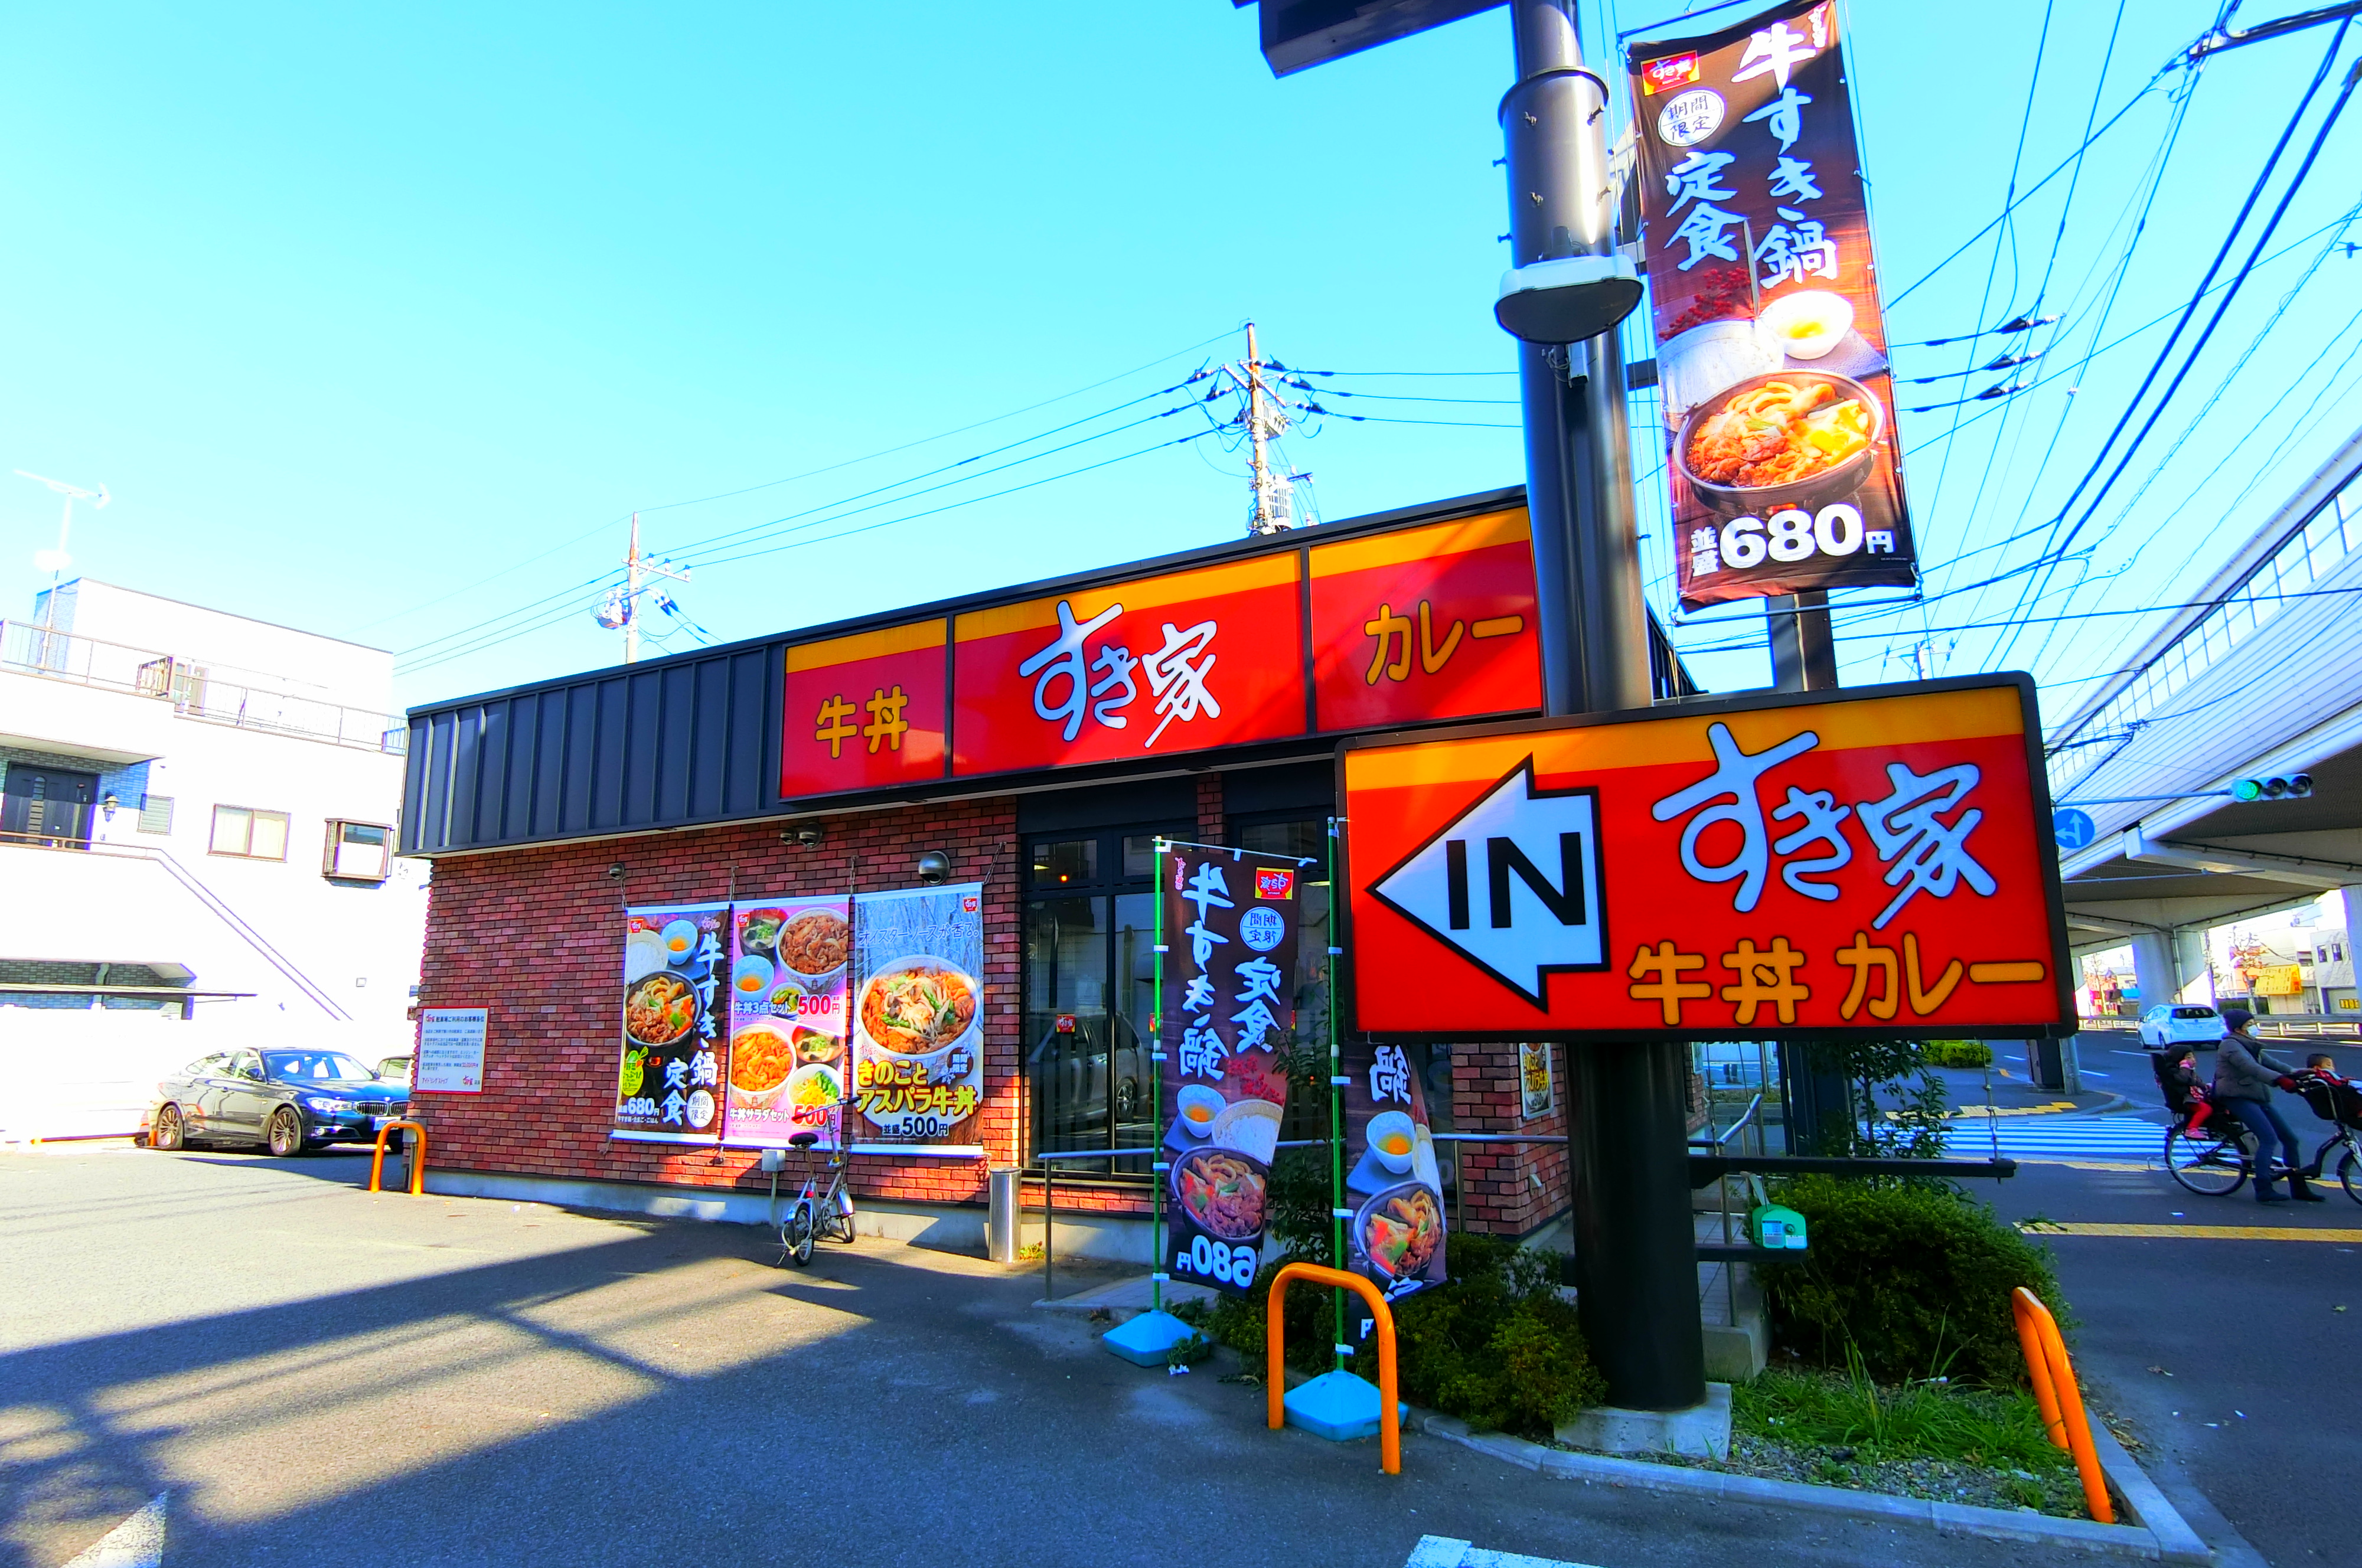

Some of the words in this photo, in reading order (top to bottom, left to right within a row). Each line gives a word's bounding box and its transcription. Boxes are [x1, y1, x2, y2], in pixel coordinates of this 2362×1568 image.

[1650, 57, 1692, 80] すき家
[1668, 95, 1708, 120] 期間
[1670, 116, 1712, 141] 限定
[1731, 22, 1838, 289] 牛すき鍋
[1665, 151, 1747, 272] 定食
[1720, 504, 1894, 569] 680円
[1365, 599, 1523, 686] カレー
[1019, 600, 1221, 749] すき家
[815, 684, 909, 759] 牛丼
[1652, 721, 1998, 930] すき家
[1446, 832, 1586, 930] IN
[859, 922, 980, 945] オイスターソースが香る。
[1628, 937, 1810, 1027] 牛丼
[1835, 930, 2045, 1023] カレー
[690, 931, 725, 1086] 牛すき鍋
[734, 1001, 791, 1015] 牛丼3点セット
[660, 1057, 690, 1126] 定食
[858, 1059, 928, 1087] きのこと
[691, 1096, 709, 1107] 期間
[691, 1109, 709, 1121] 限定
[729, 1108, 790, 1122] 牛丼サラダセット
[856, 1085, 978, 1116] アスパラ牛丼
[883, 1116, 950, 1137] 並盛500円
